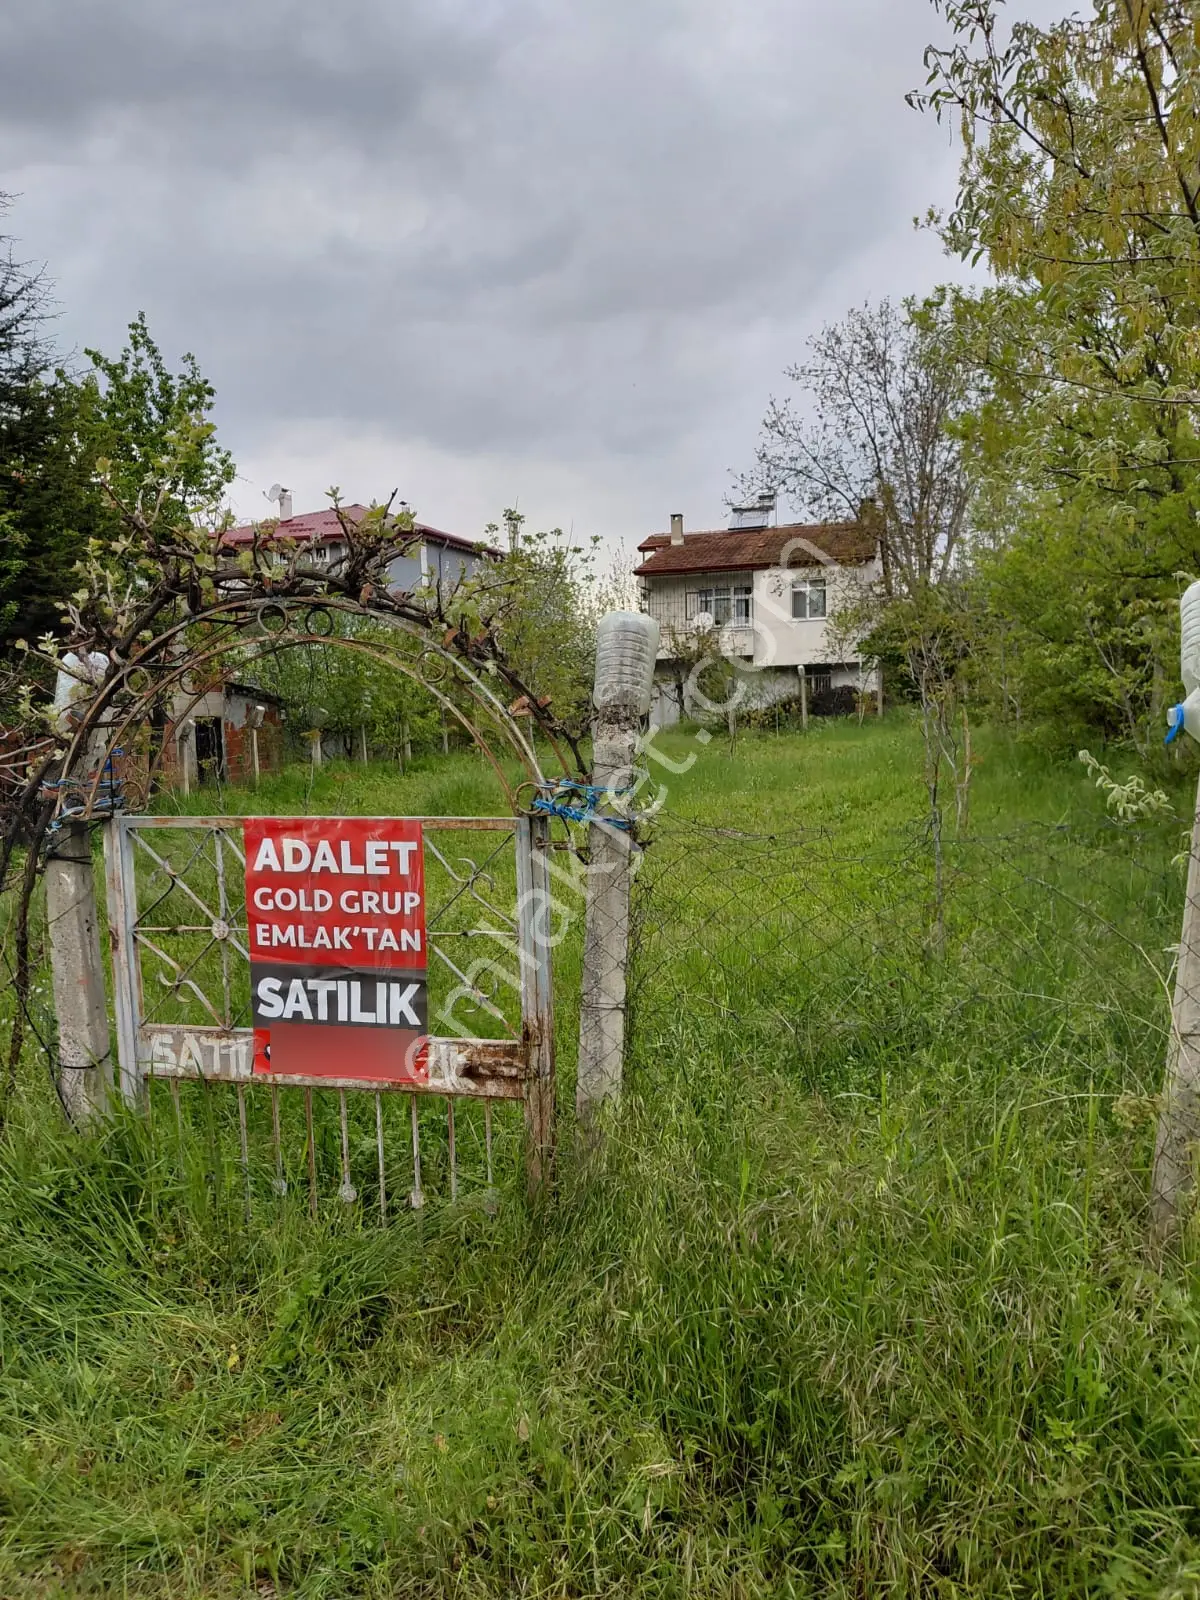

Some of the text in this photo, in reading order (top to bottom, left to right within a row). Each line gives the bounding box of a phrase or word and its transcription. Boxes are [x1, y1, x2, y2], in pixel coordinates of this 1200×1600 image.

[253, 838, 418, 875] ADALET
[253, 887, 421, 915] GOLD GRUP
[256, 923, 421, 952] EMLAK'TAN
[257, 977, 422, 1026] SATILIK
